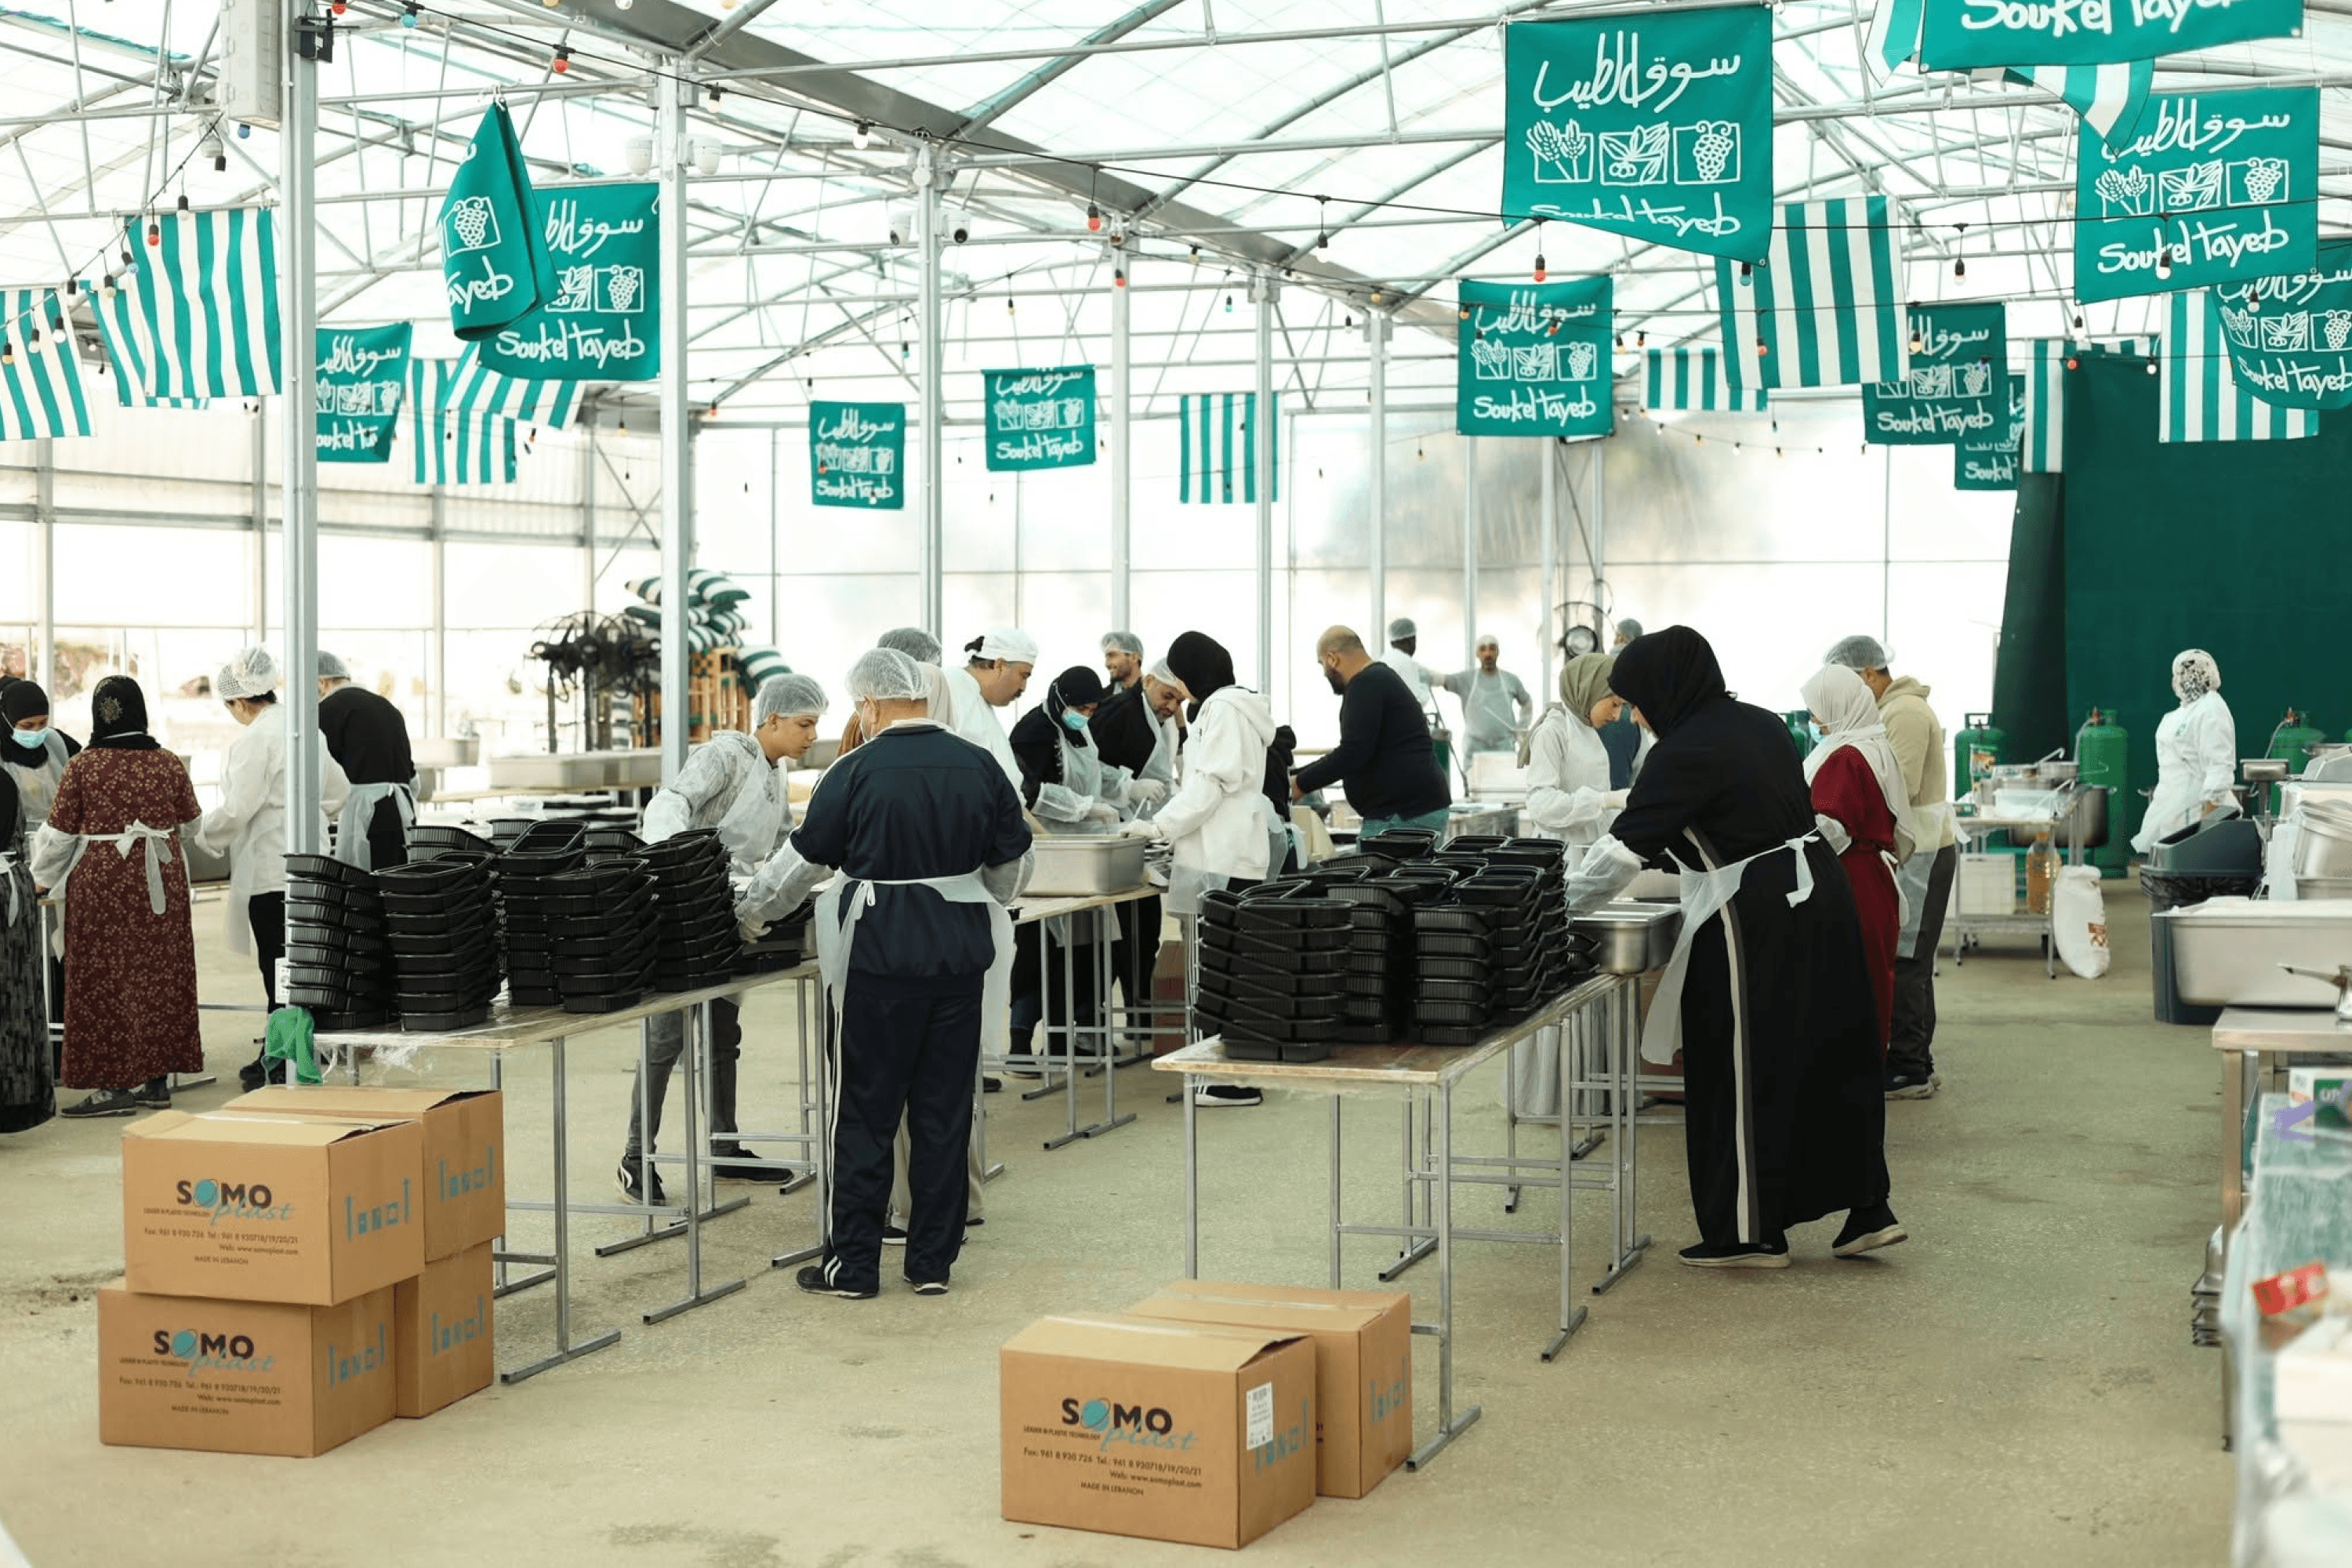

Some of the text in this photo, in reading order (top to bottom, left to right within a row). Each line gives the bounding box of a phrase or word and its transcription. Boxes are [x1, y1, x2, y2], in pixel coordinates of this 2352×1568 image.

[1533, 31, 1740, 113] سوق الطيب
[2198, 114, 2290, 154] سوق
[1635, 192, 1740, 237] Tayeb
[574, 218, 644, 259] سوق
[2192, 210, 2289, 267] Tayeb
[354, 347, 401, 378] سوق
[568, 318, 645, 369] Tayeb
[1933, 328, 1990, 359] سوق
[1536, 384, 1597, 427] Tayeb
[1935, 399, 1994, 437] Tayeb
[176, 1178, 273, 1209] SOMO
[154, 1329, 255, 1360] SOMO
[1062, 1397, 1174, 1436] SOMO
